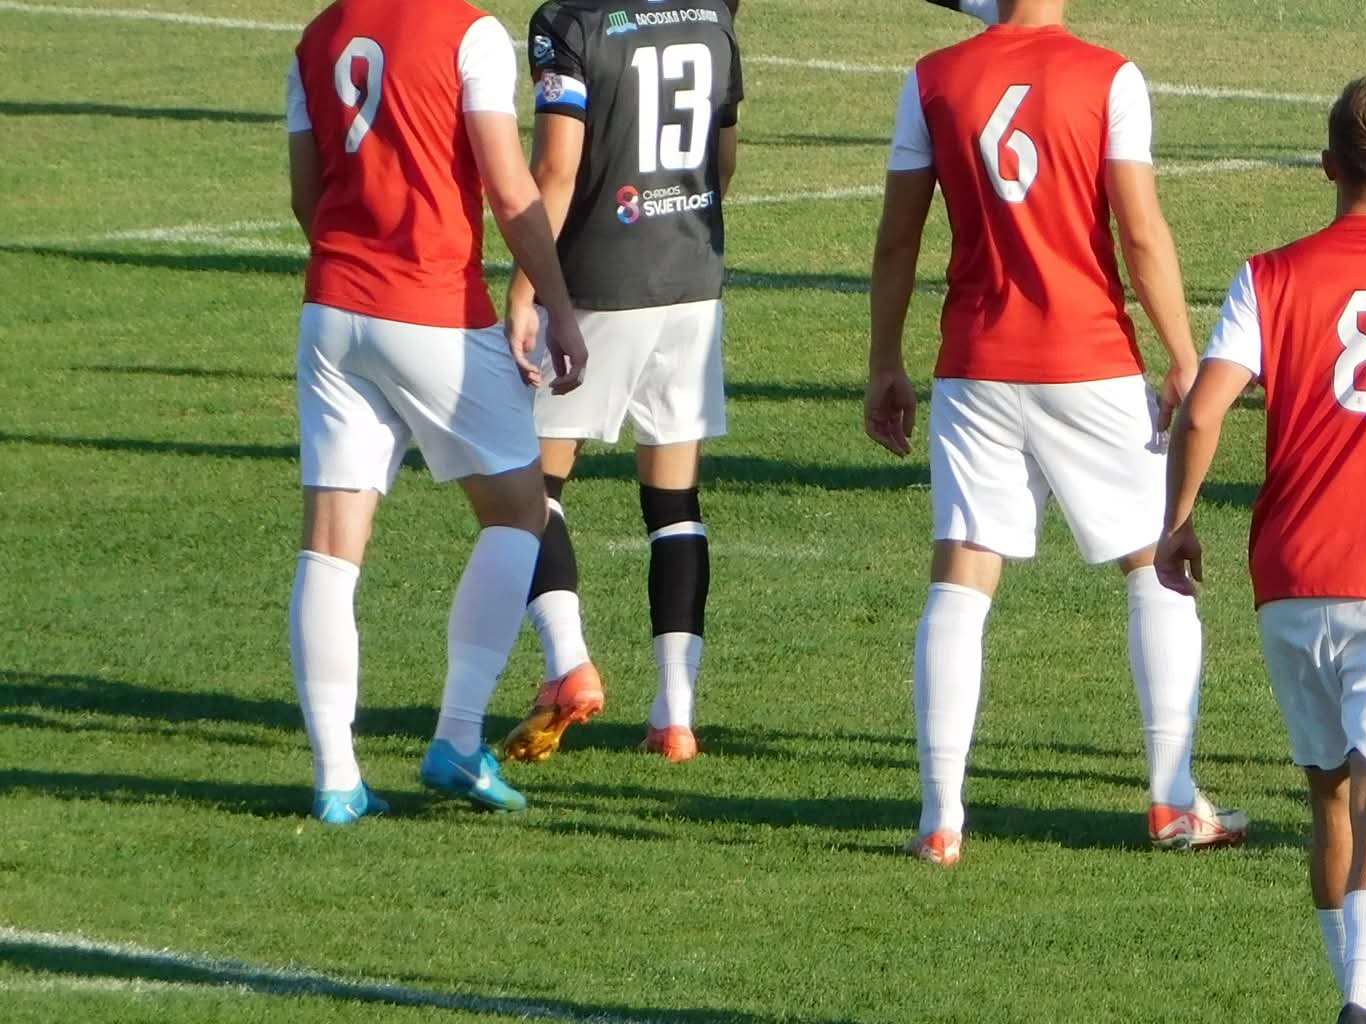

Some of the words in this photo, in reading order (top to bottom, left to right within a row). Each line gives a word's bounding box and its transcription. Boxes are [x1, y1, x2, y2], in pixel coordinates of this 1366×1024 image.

[334, 36, 384, 153] 9
[630, 43, 713, 173] 13
[978, 84, 1039, 204] 6
[643, 190, 715, 217] SVJETLOST
